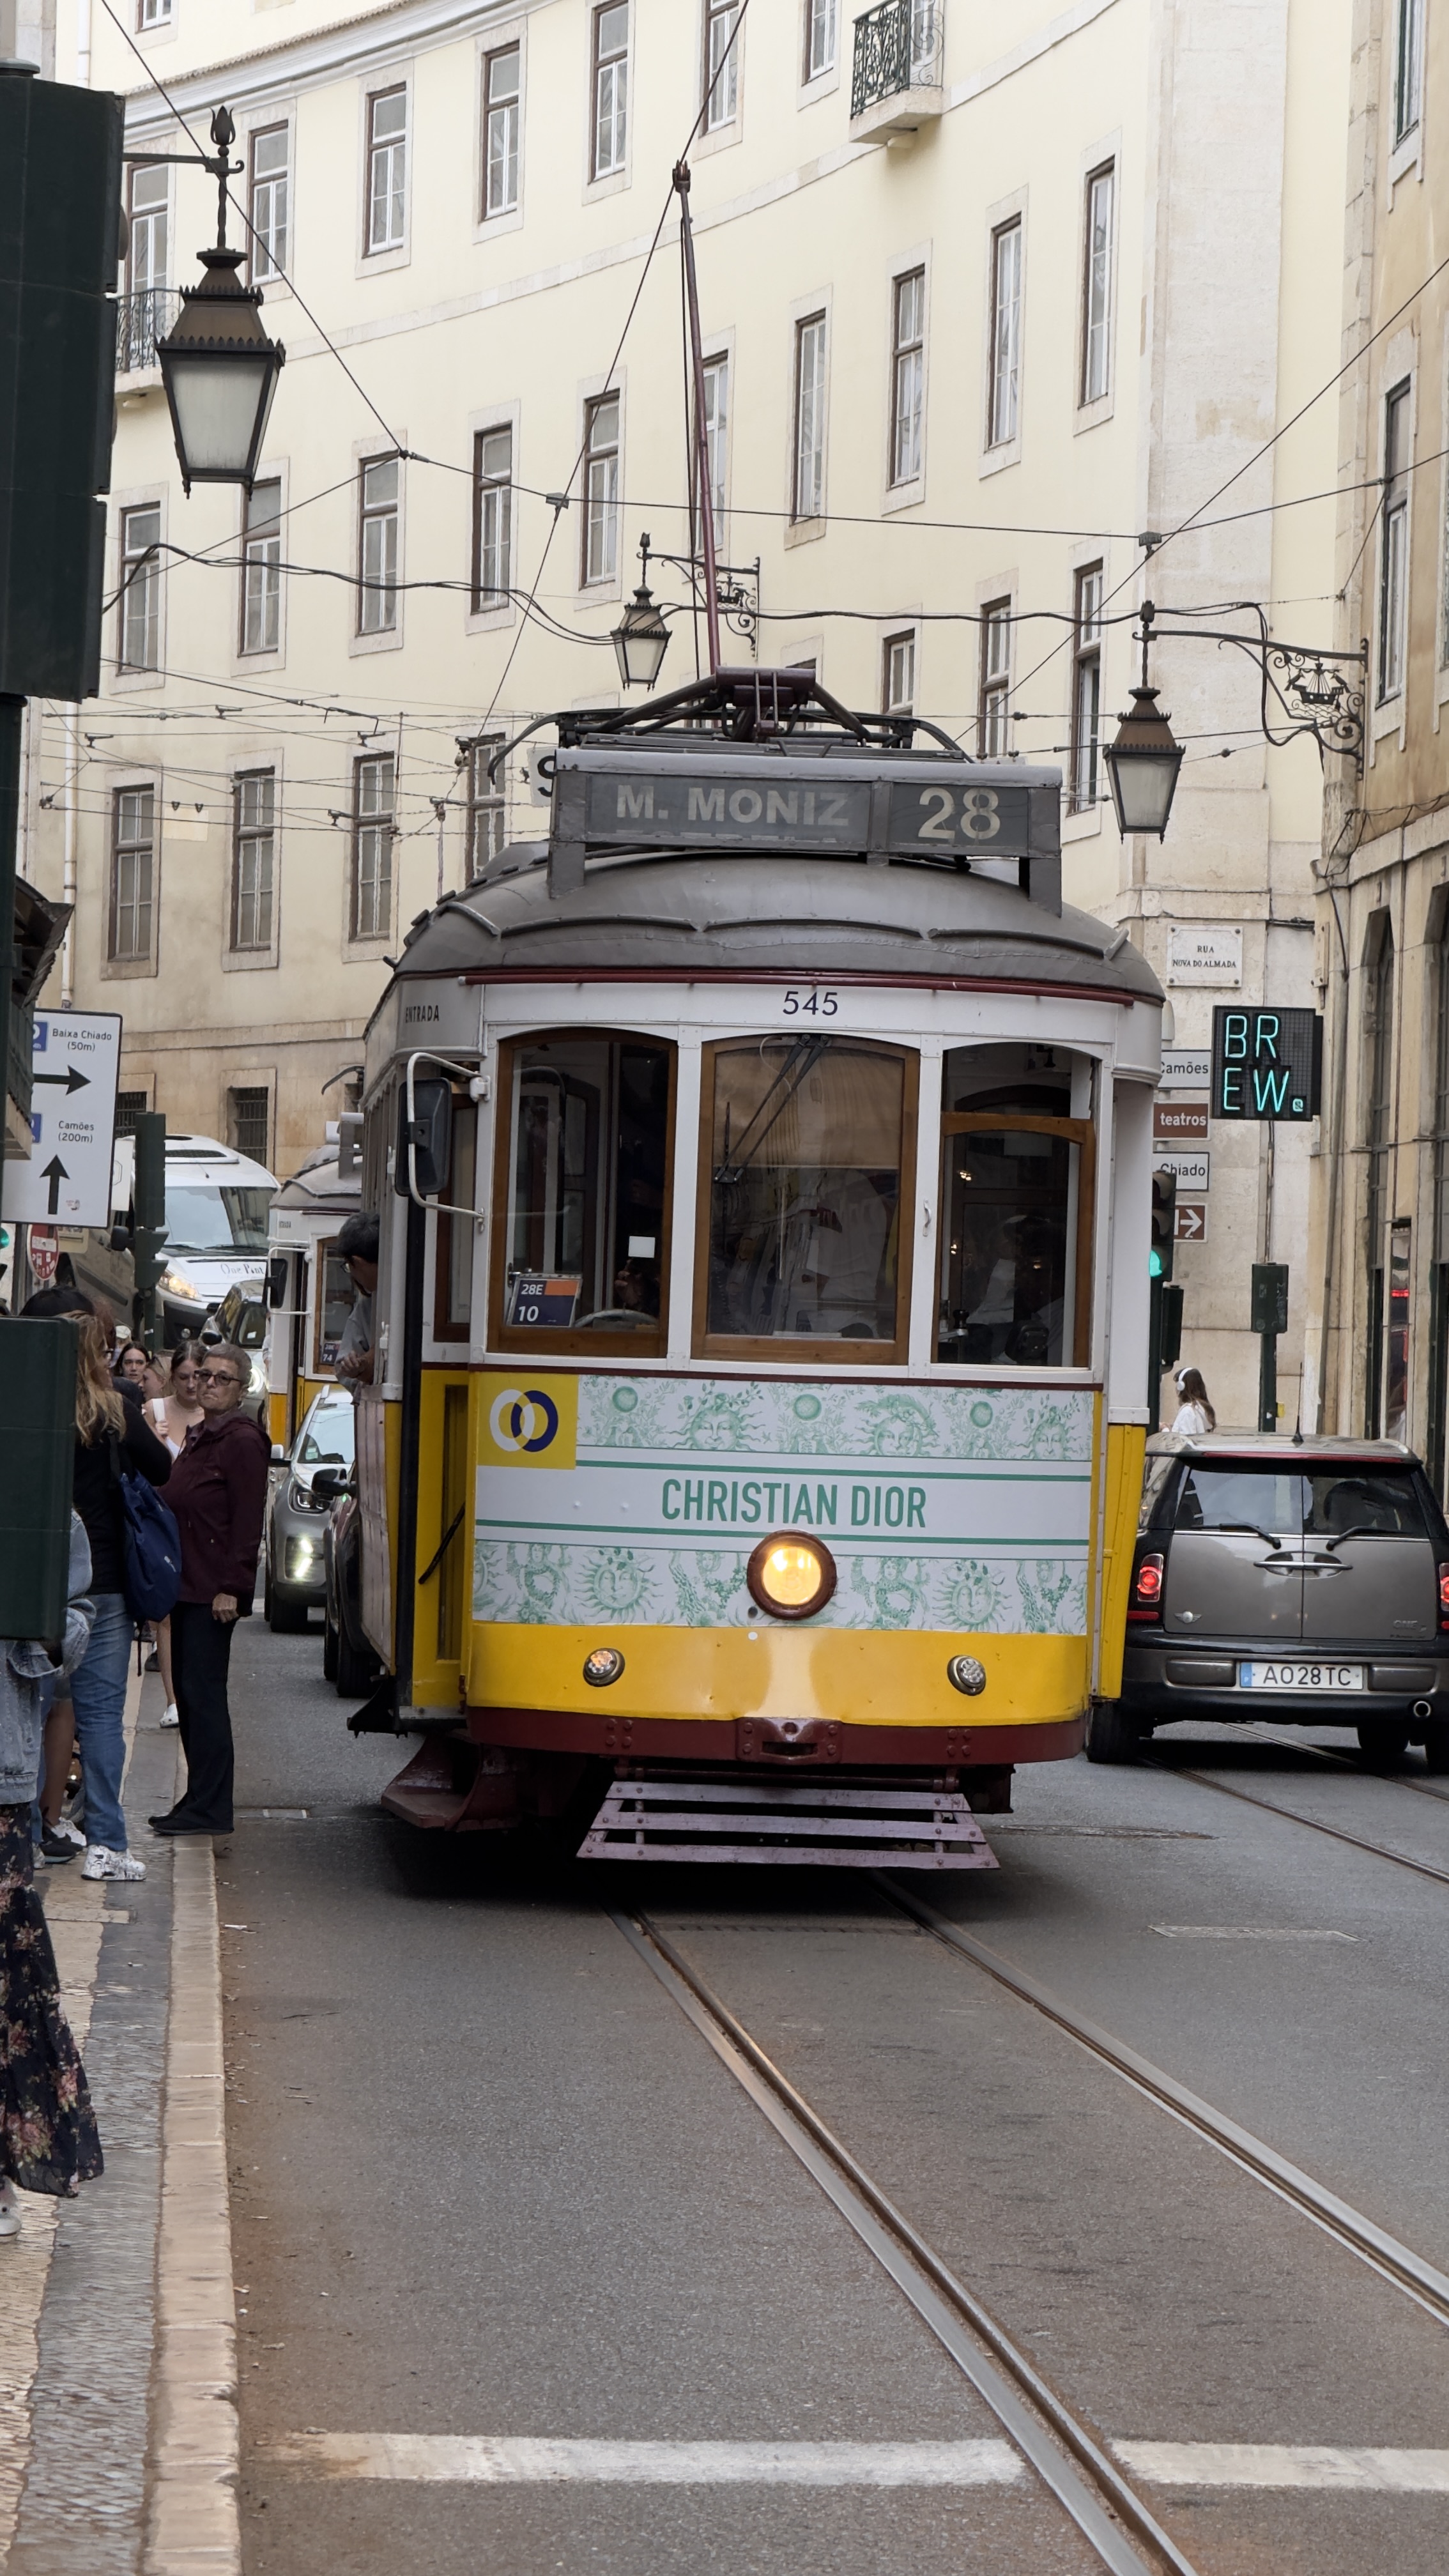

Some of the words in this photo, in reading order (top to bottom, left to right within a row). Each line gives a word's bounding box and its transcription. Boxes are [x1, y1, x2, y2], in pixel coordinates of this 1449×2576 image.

[617, 785, 669, 820] M.
[687, 787, 849, 826] MONIZ
[917, 786, 1000, 840] 28
[1197, 945, 1215, 953] RUA
[1172, 959, 1192, 967] NOVA
[1203, 960, 1237, 969] ALMADA
[783, 990, 838, 1016] 545
[405, 1004, 440, 1023] ENTRADA
[52, 1028, 78, 1038] Baixa
[81, 1030, 112, 1041] Chiado
[1225, 1015, 1278, 1059] BR
[67, 1041, 96, 1052] (50m)
[58, 1120, 95, 1131] Camões
[1160, 1112, 1207, 1126] teatros
[58, 1133, 93, 1144] (200m)
[521, 1284, 544, 1295] 28E
[518, 1305, 539, 1322] 10
[662, 1478, 838, 1525] CHRISTIAN
[851, 1485, 926, 1528] DIOR
